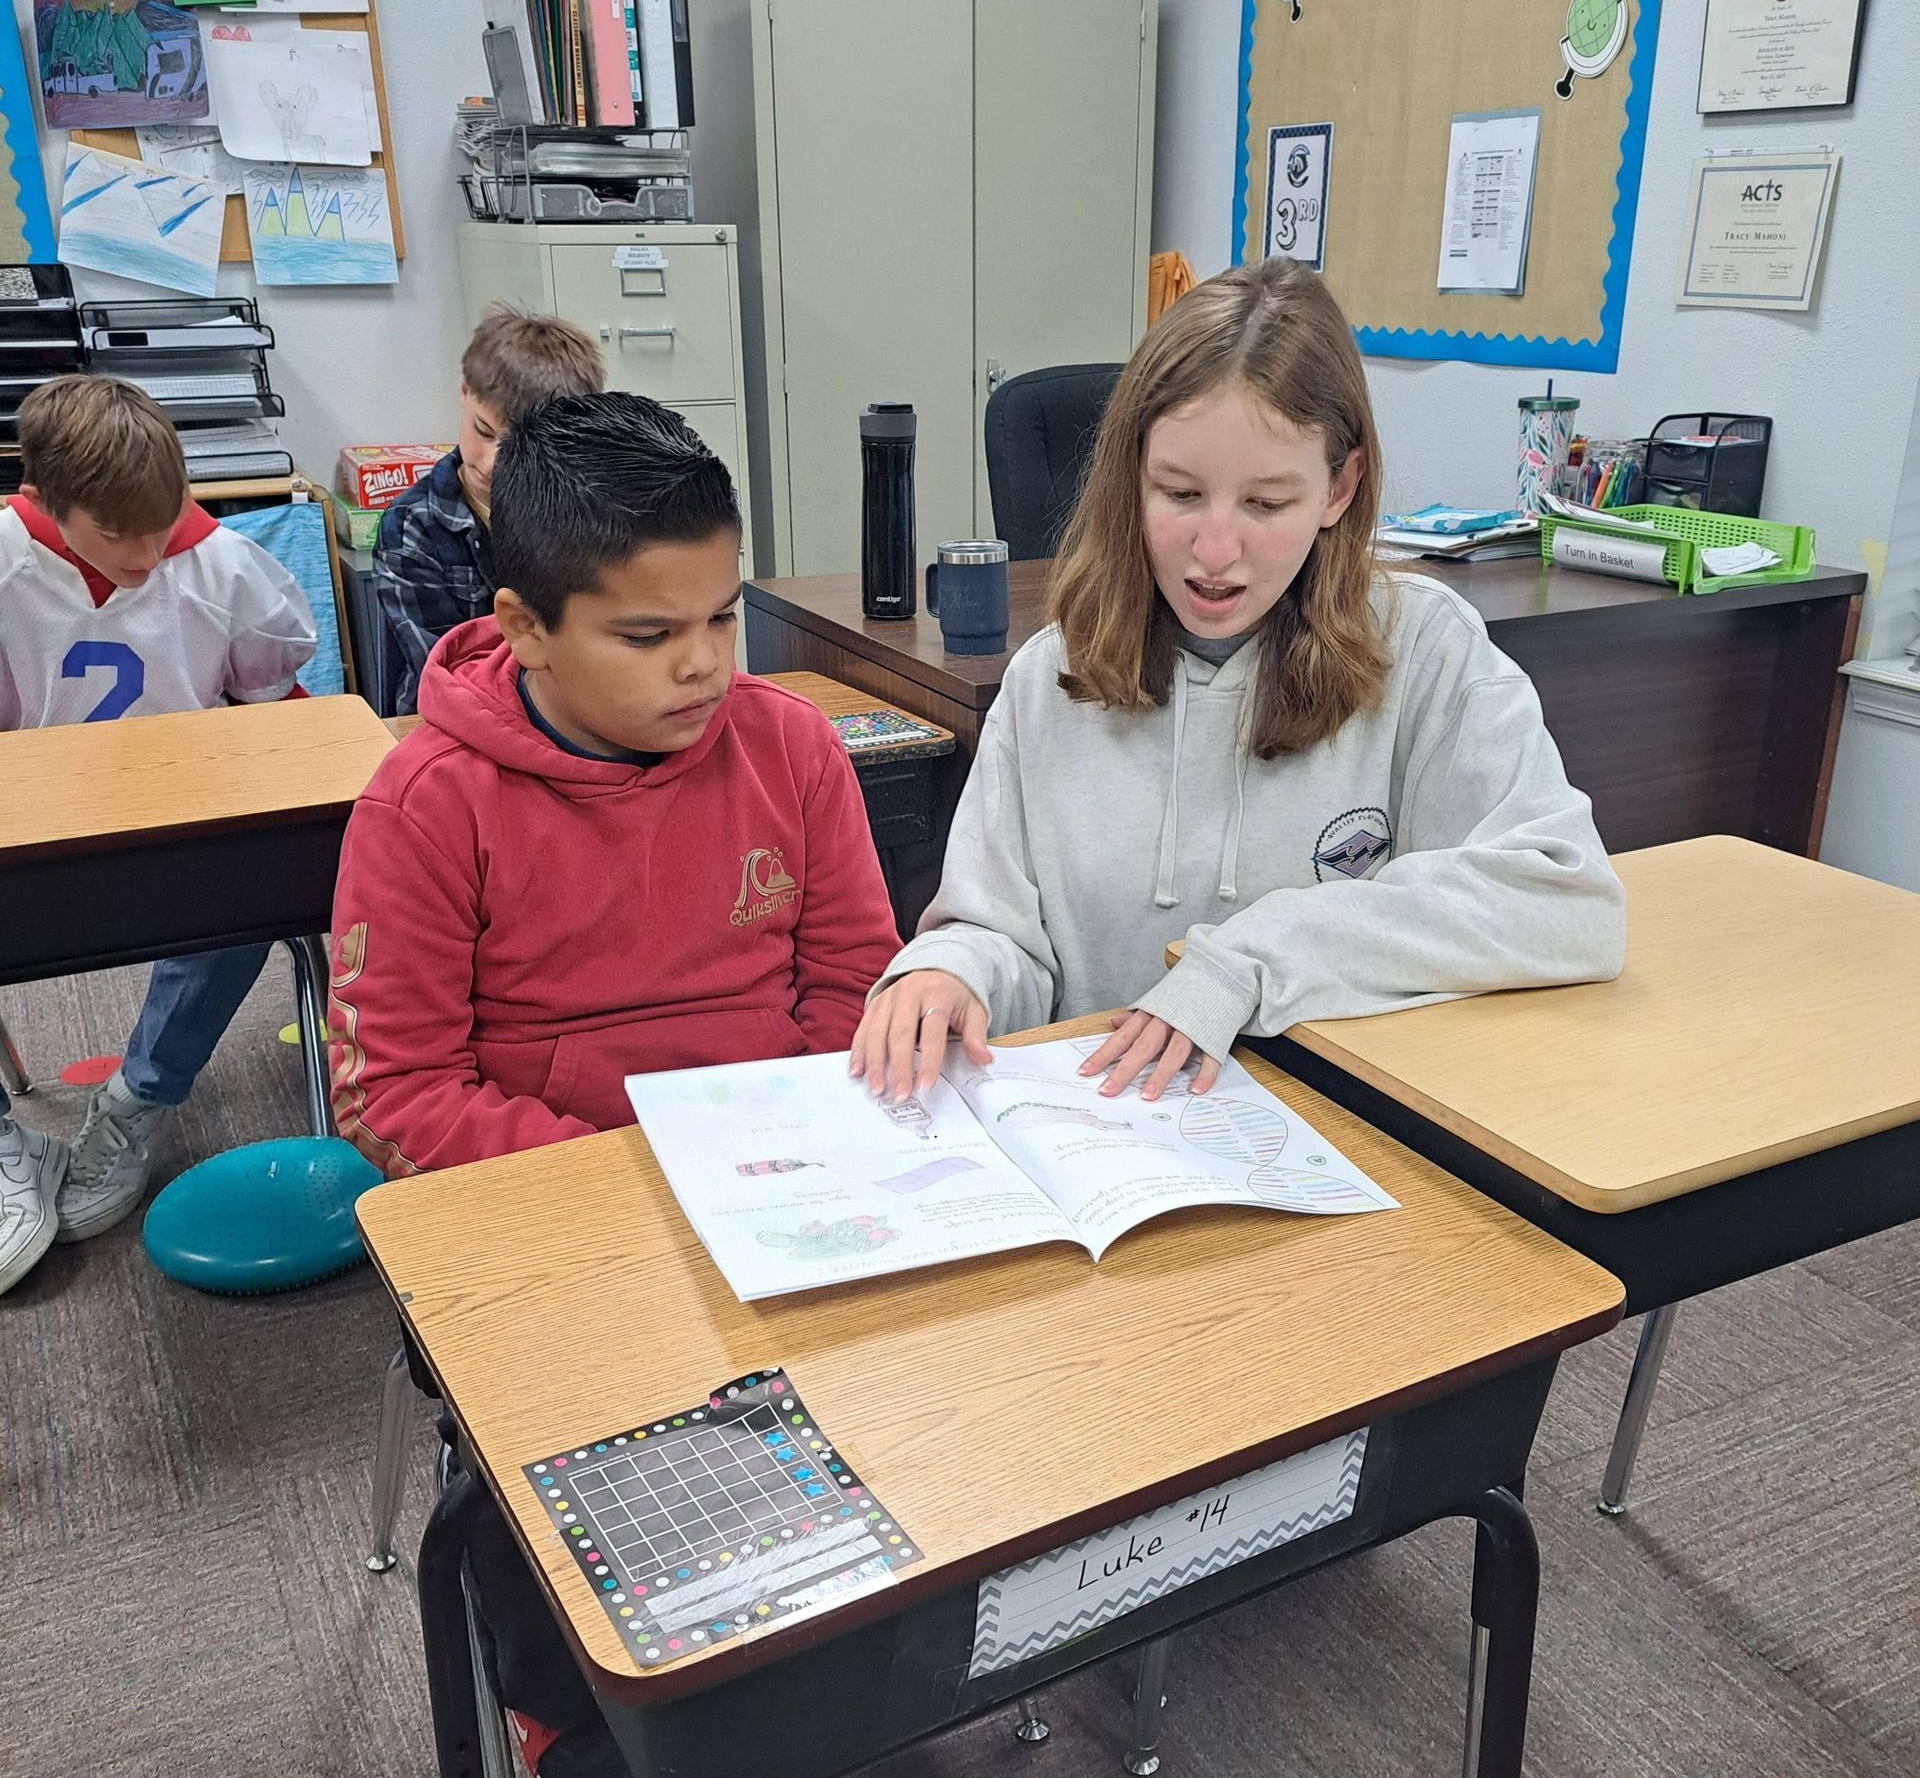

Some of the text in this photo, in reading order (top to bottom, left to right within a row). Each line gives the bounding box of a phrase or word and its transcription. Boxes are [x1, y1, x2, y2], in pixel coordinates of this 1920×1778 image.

[572, 10, 583, 89] CLASSROOM MANAGEMENT
[1741, 179, 1783, 201] ACTS
[1724, 231, 1787, 241] TRACY MAHONI
[362, 463, 409, 493] ZINGO!
[1564, 543, 1587, 559] Turn
[1600, 549, 1634, 569] Basket
[876, 596, 902, 604] contigo
[61, 640, 145, 723] 2
[1076, 1493, 1231, 1592] Luke #14
